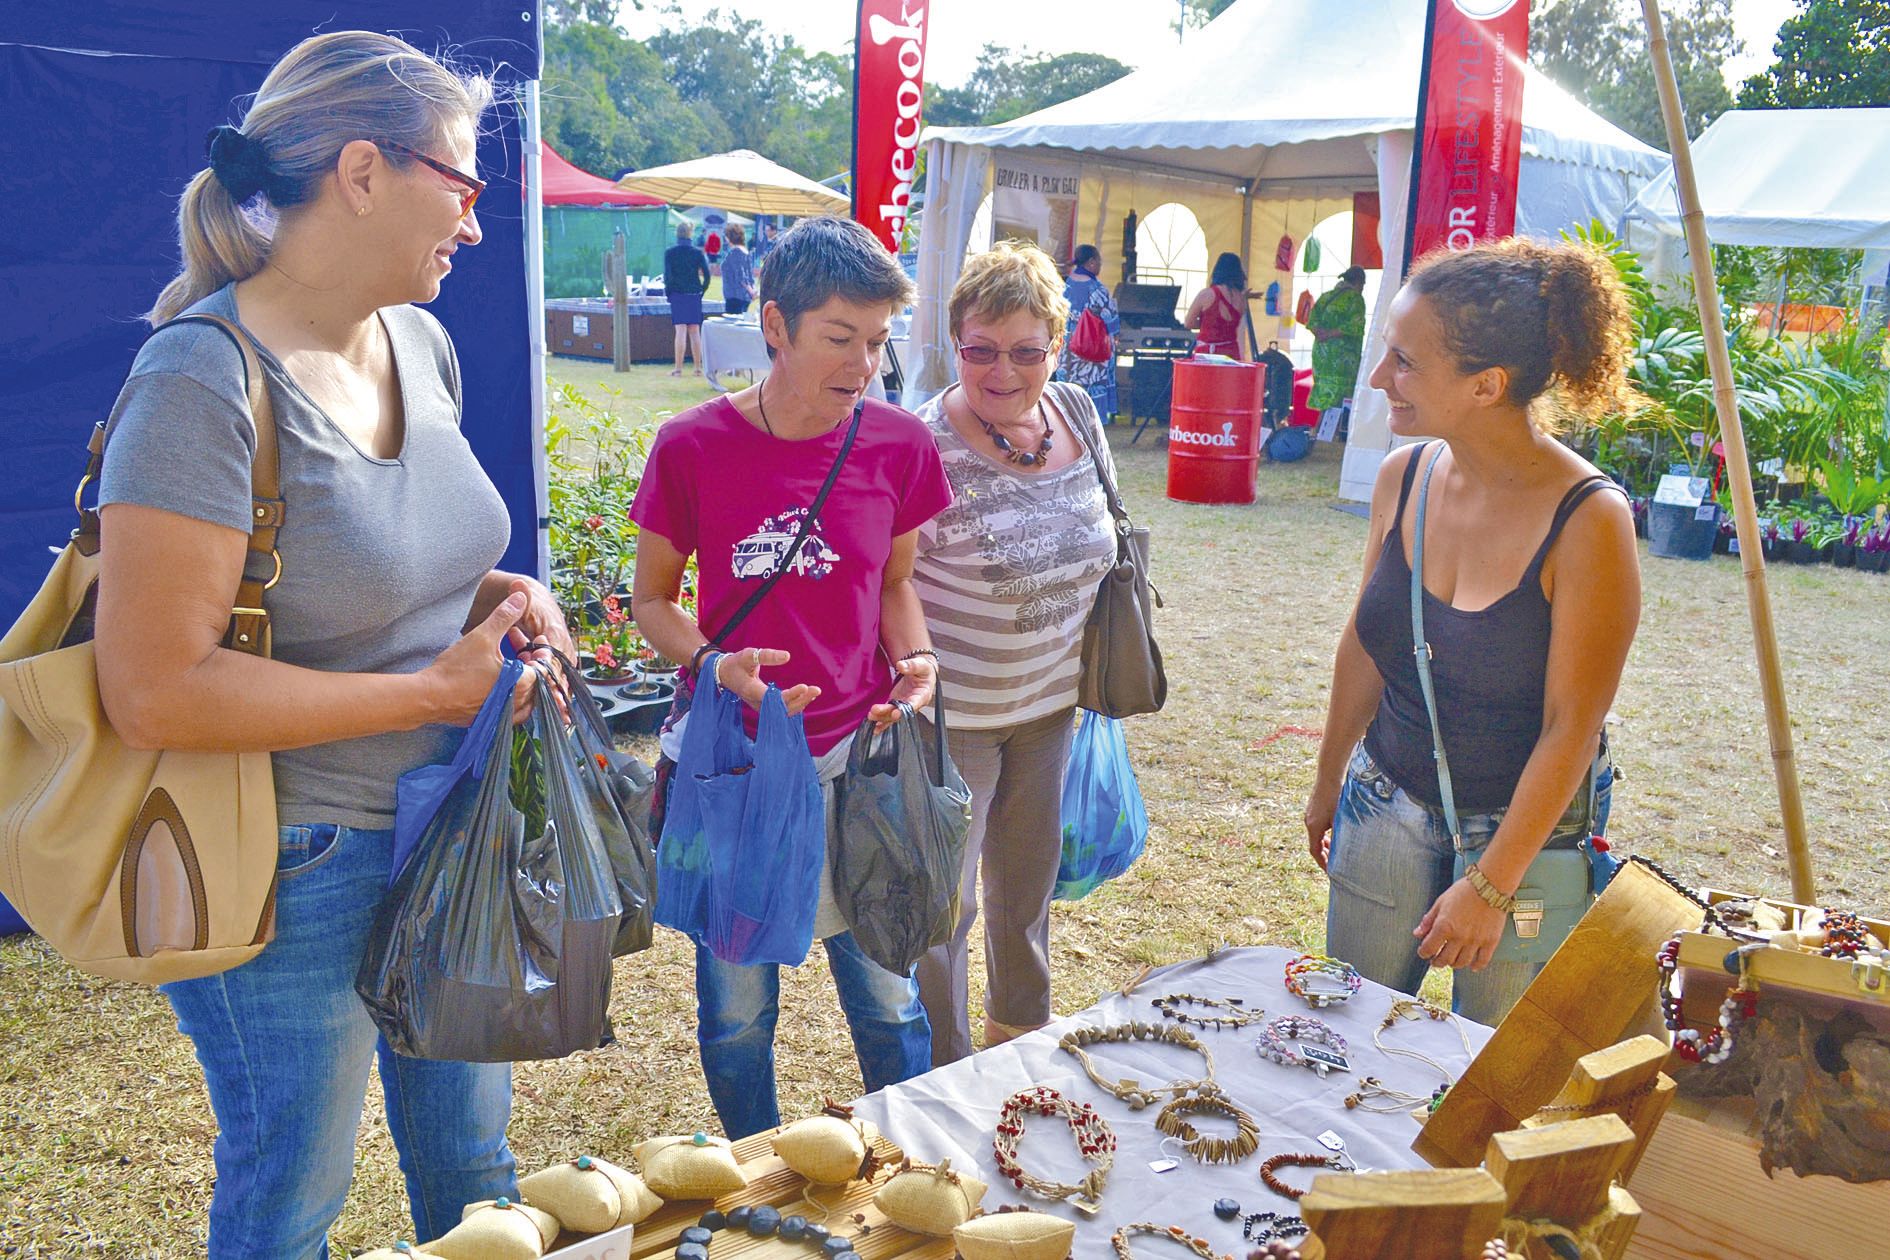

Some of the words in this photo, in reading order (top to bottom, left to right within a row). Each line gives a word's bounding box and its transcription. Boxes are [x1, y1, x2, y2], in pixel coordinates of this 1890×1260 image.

[869, 0, 925, 254] rbecook
[997, 168, 1030, 191] GRILLER
[1451, 27, 1484, 196] LIFESTYLE
